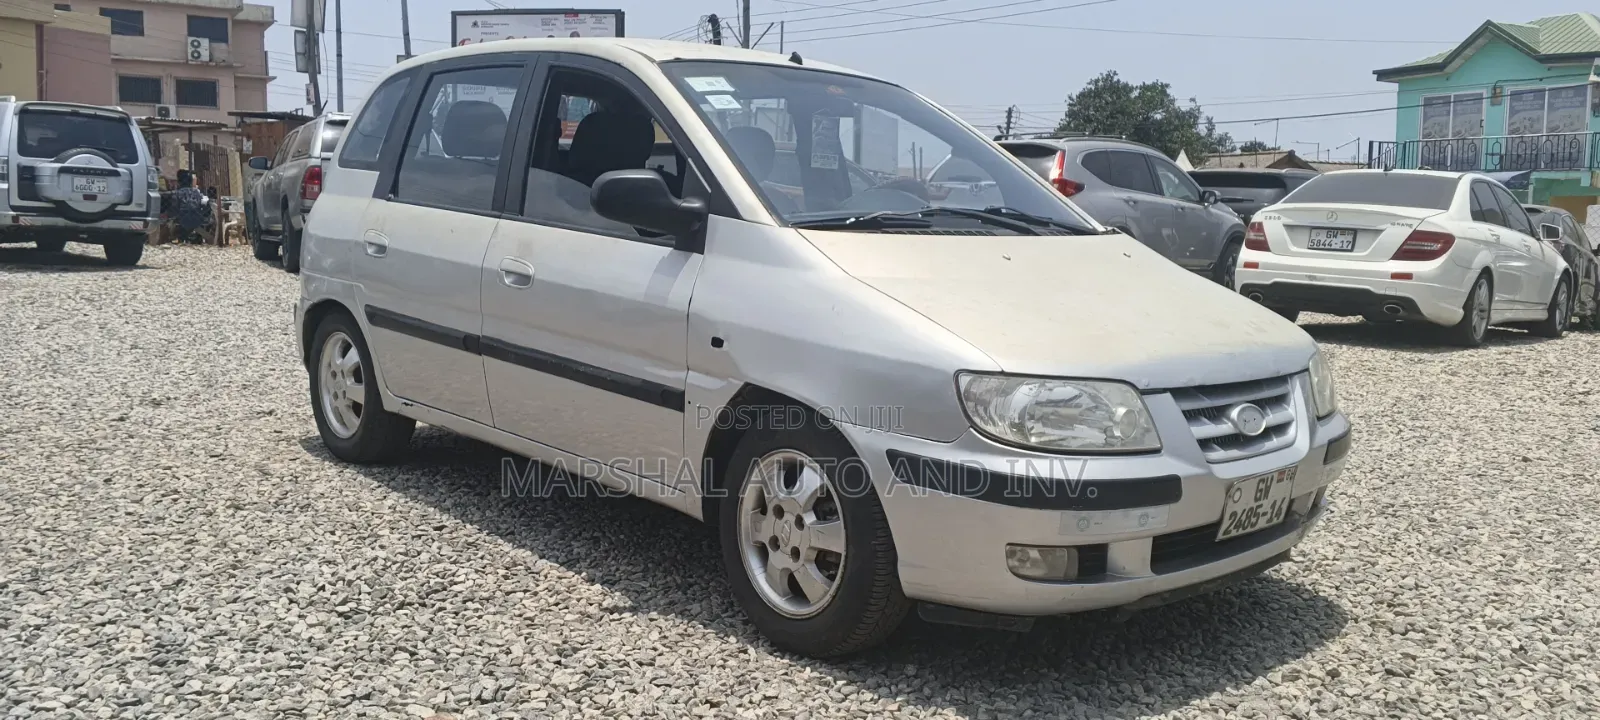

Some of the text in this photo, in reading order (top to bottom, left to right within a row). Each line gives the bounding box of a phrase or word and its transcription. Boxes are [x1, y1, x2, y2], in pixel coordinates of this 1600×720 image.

[1309, 239, 1352, 248] 5844-17
[1326, 230, 1339, 239] GW
[1254, 475, 1274, 502] GW
[1224, 497, 1285, 535] 2485-14
